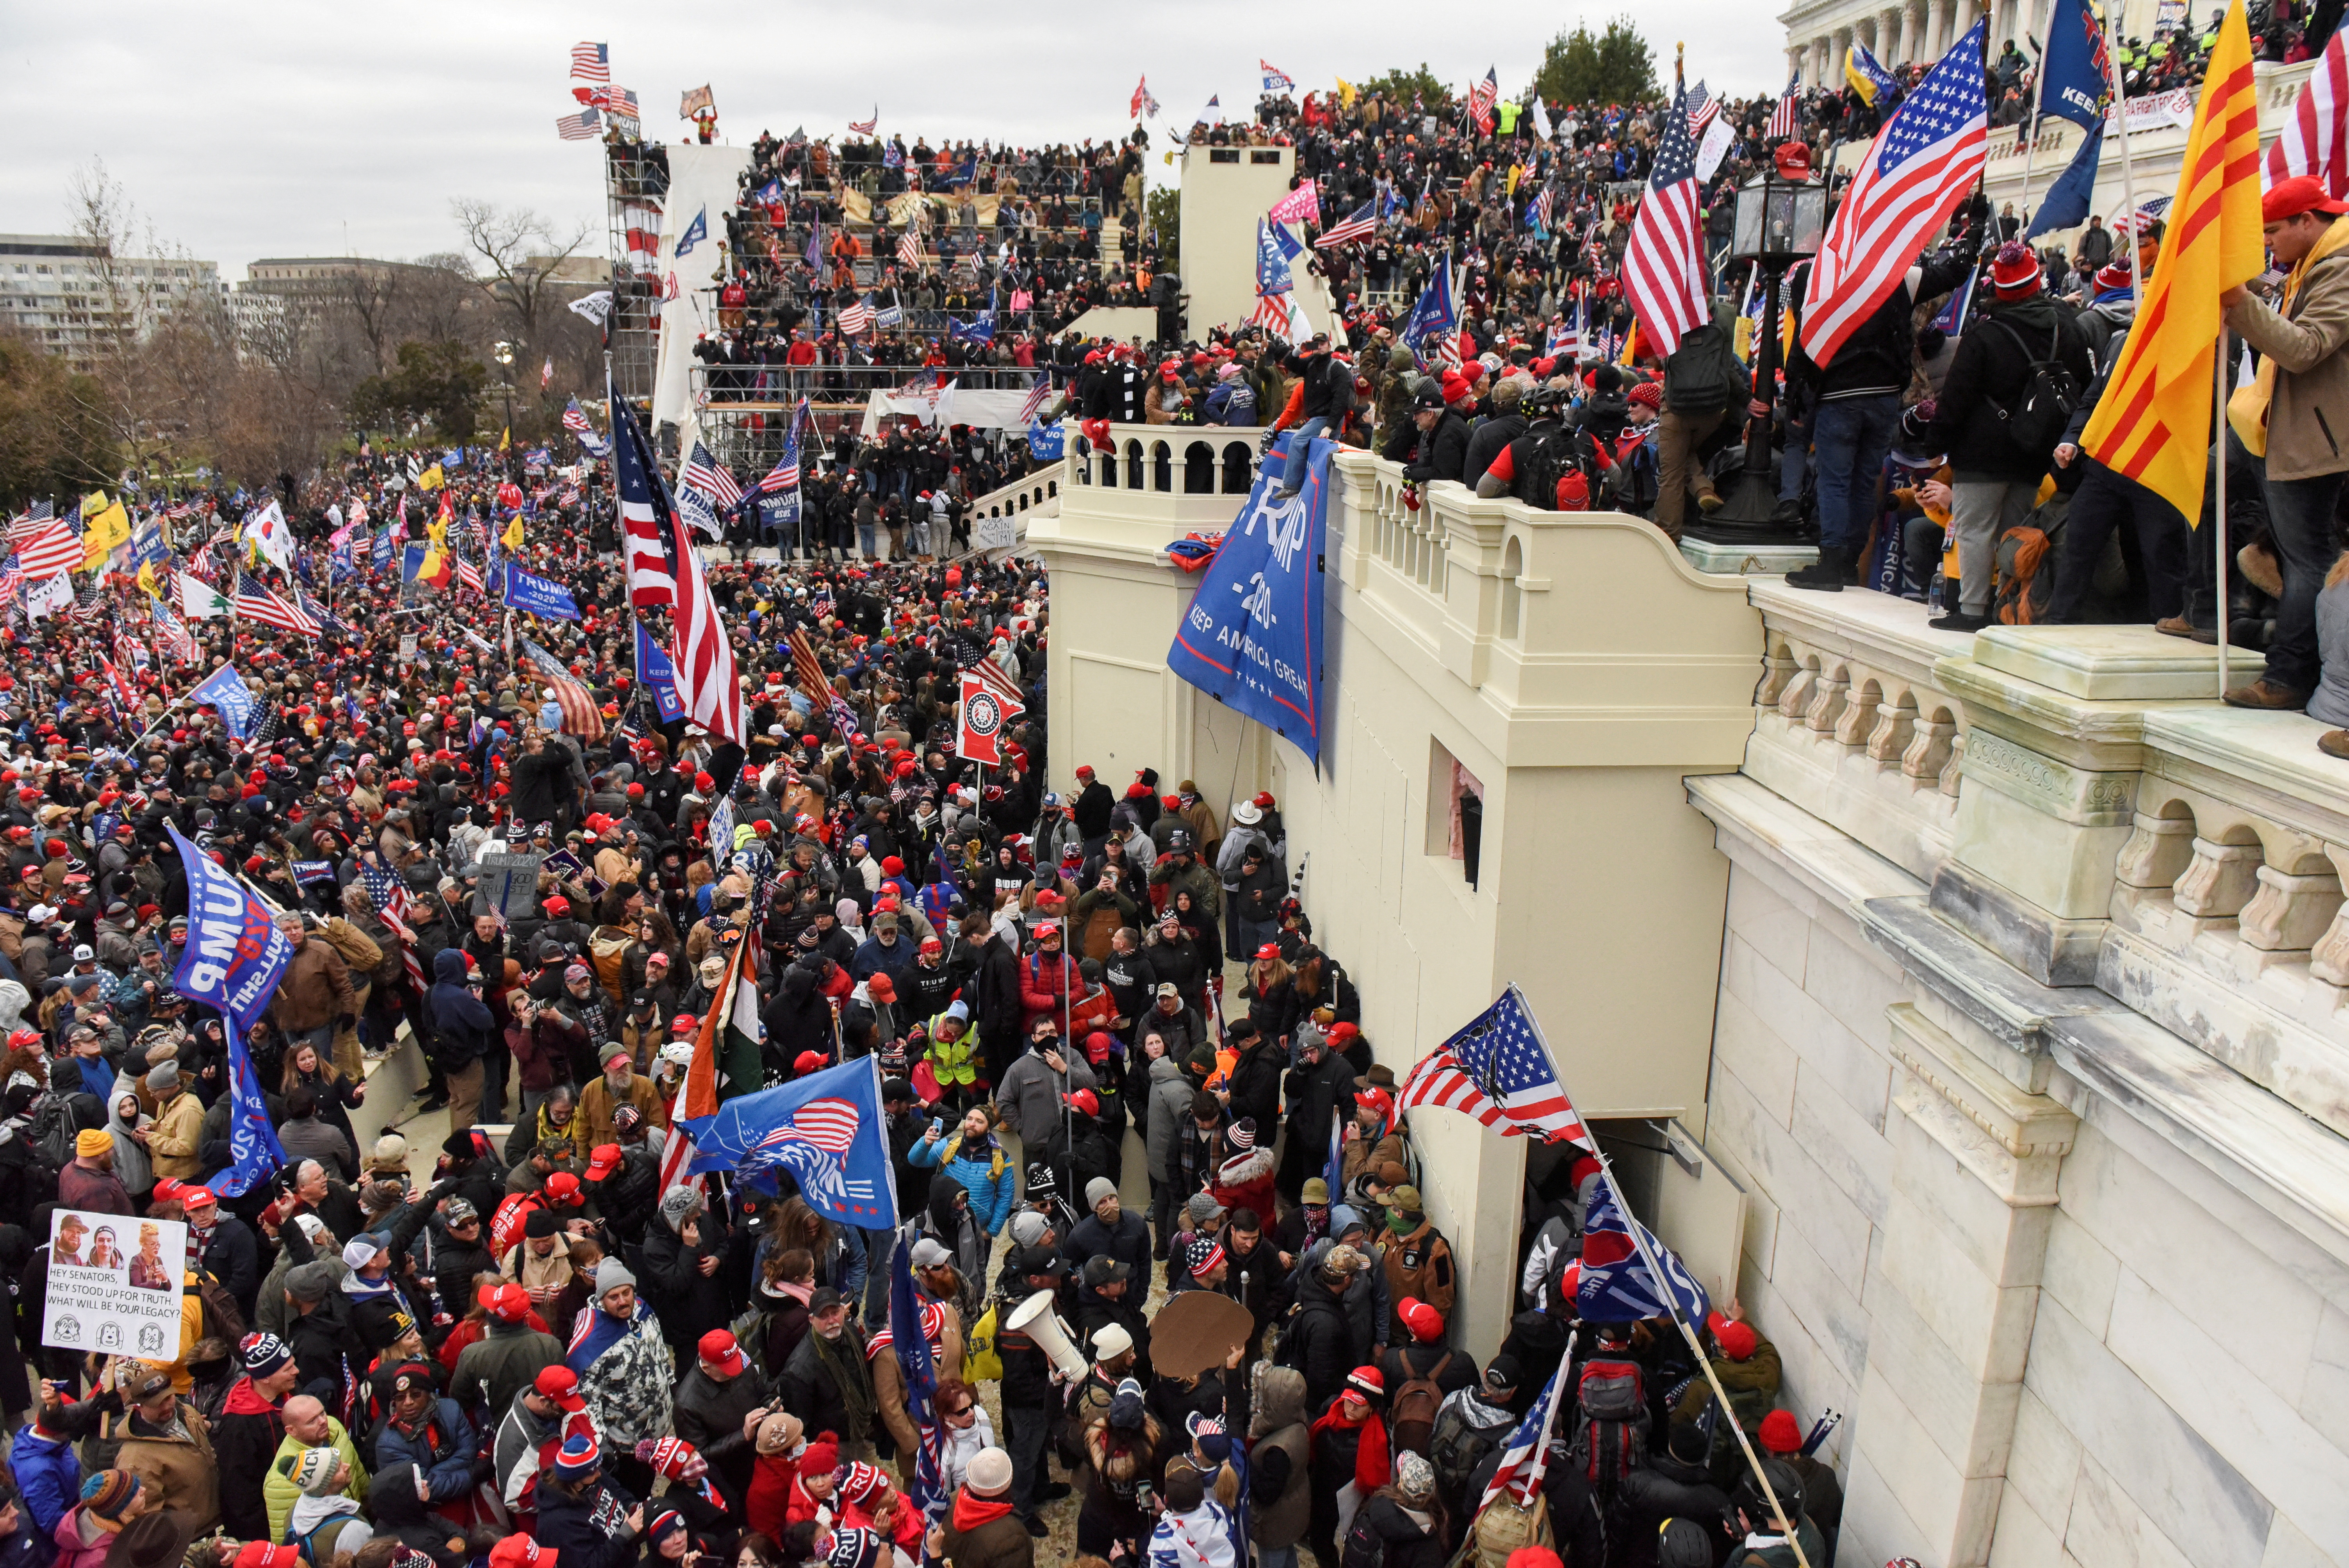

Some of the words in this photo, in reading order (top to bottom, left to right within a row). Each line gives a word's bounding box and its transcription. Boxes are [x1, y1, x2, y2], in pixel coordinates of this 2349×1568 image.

[1269, 77, 1289, 86] 202
[2137, 99, 2157, 116] FIGHT
[688, 506, 707, 519] 2020
[981, 522, 1010, 531] AGAIN
[518, 573, 569, 596] TRUMP
[528, 591, 559, 604] -2020-
[529, 599, 551, 609] AMERICA
[1189, 603, 1213, 633] KEEP
[488, 854, 511, 866] TRUMP
[512, 855, 538, 866] 2020
[293, 861, 329, 873] TRUMP
[511, 873, 533, 884] GOD
[995, 878, 1022, 888] BIDEN
[920, 977, 947, 986] TRUMP
[188, 1193, 206, 1202] USA
[50, 1268, 68, 1277] HEY
[70, 1270, 118, 1284] SENATORS,
[47, 1281, 69, 1292] THEY
[71, 1285, 104, 1296] STOOD
[106, 1288, 119, 1298] UP
[120, 1290, 139, 1300] FOR
[142, 1292, 173, 1305] TRUTH.
[47, 1295, 74, 1306] WHAT
[77, 1297, 99, 1308] WILL
[101, 1300, 112, 1310] BE
[116, 1301, 141, 1313] YOUR
[141, 1304, 180, 1318] LEGACY?
[248, 1333, 280, 1362] TRUM
